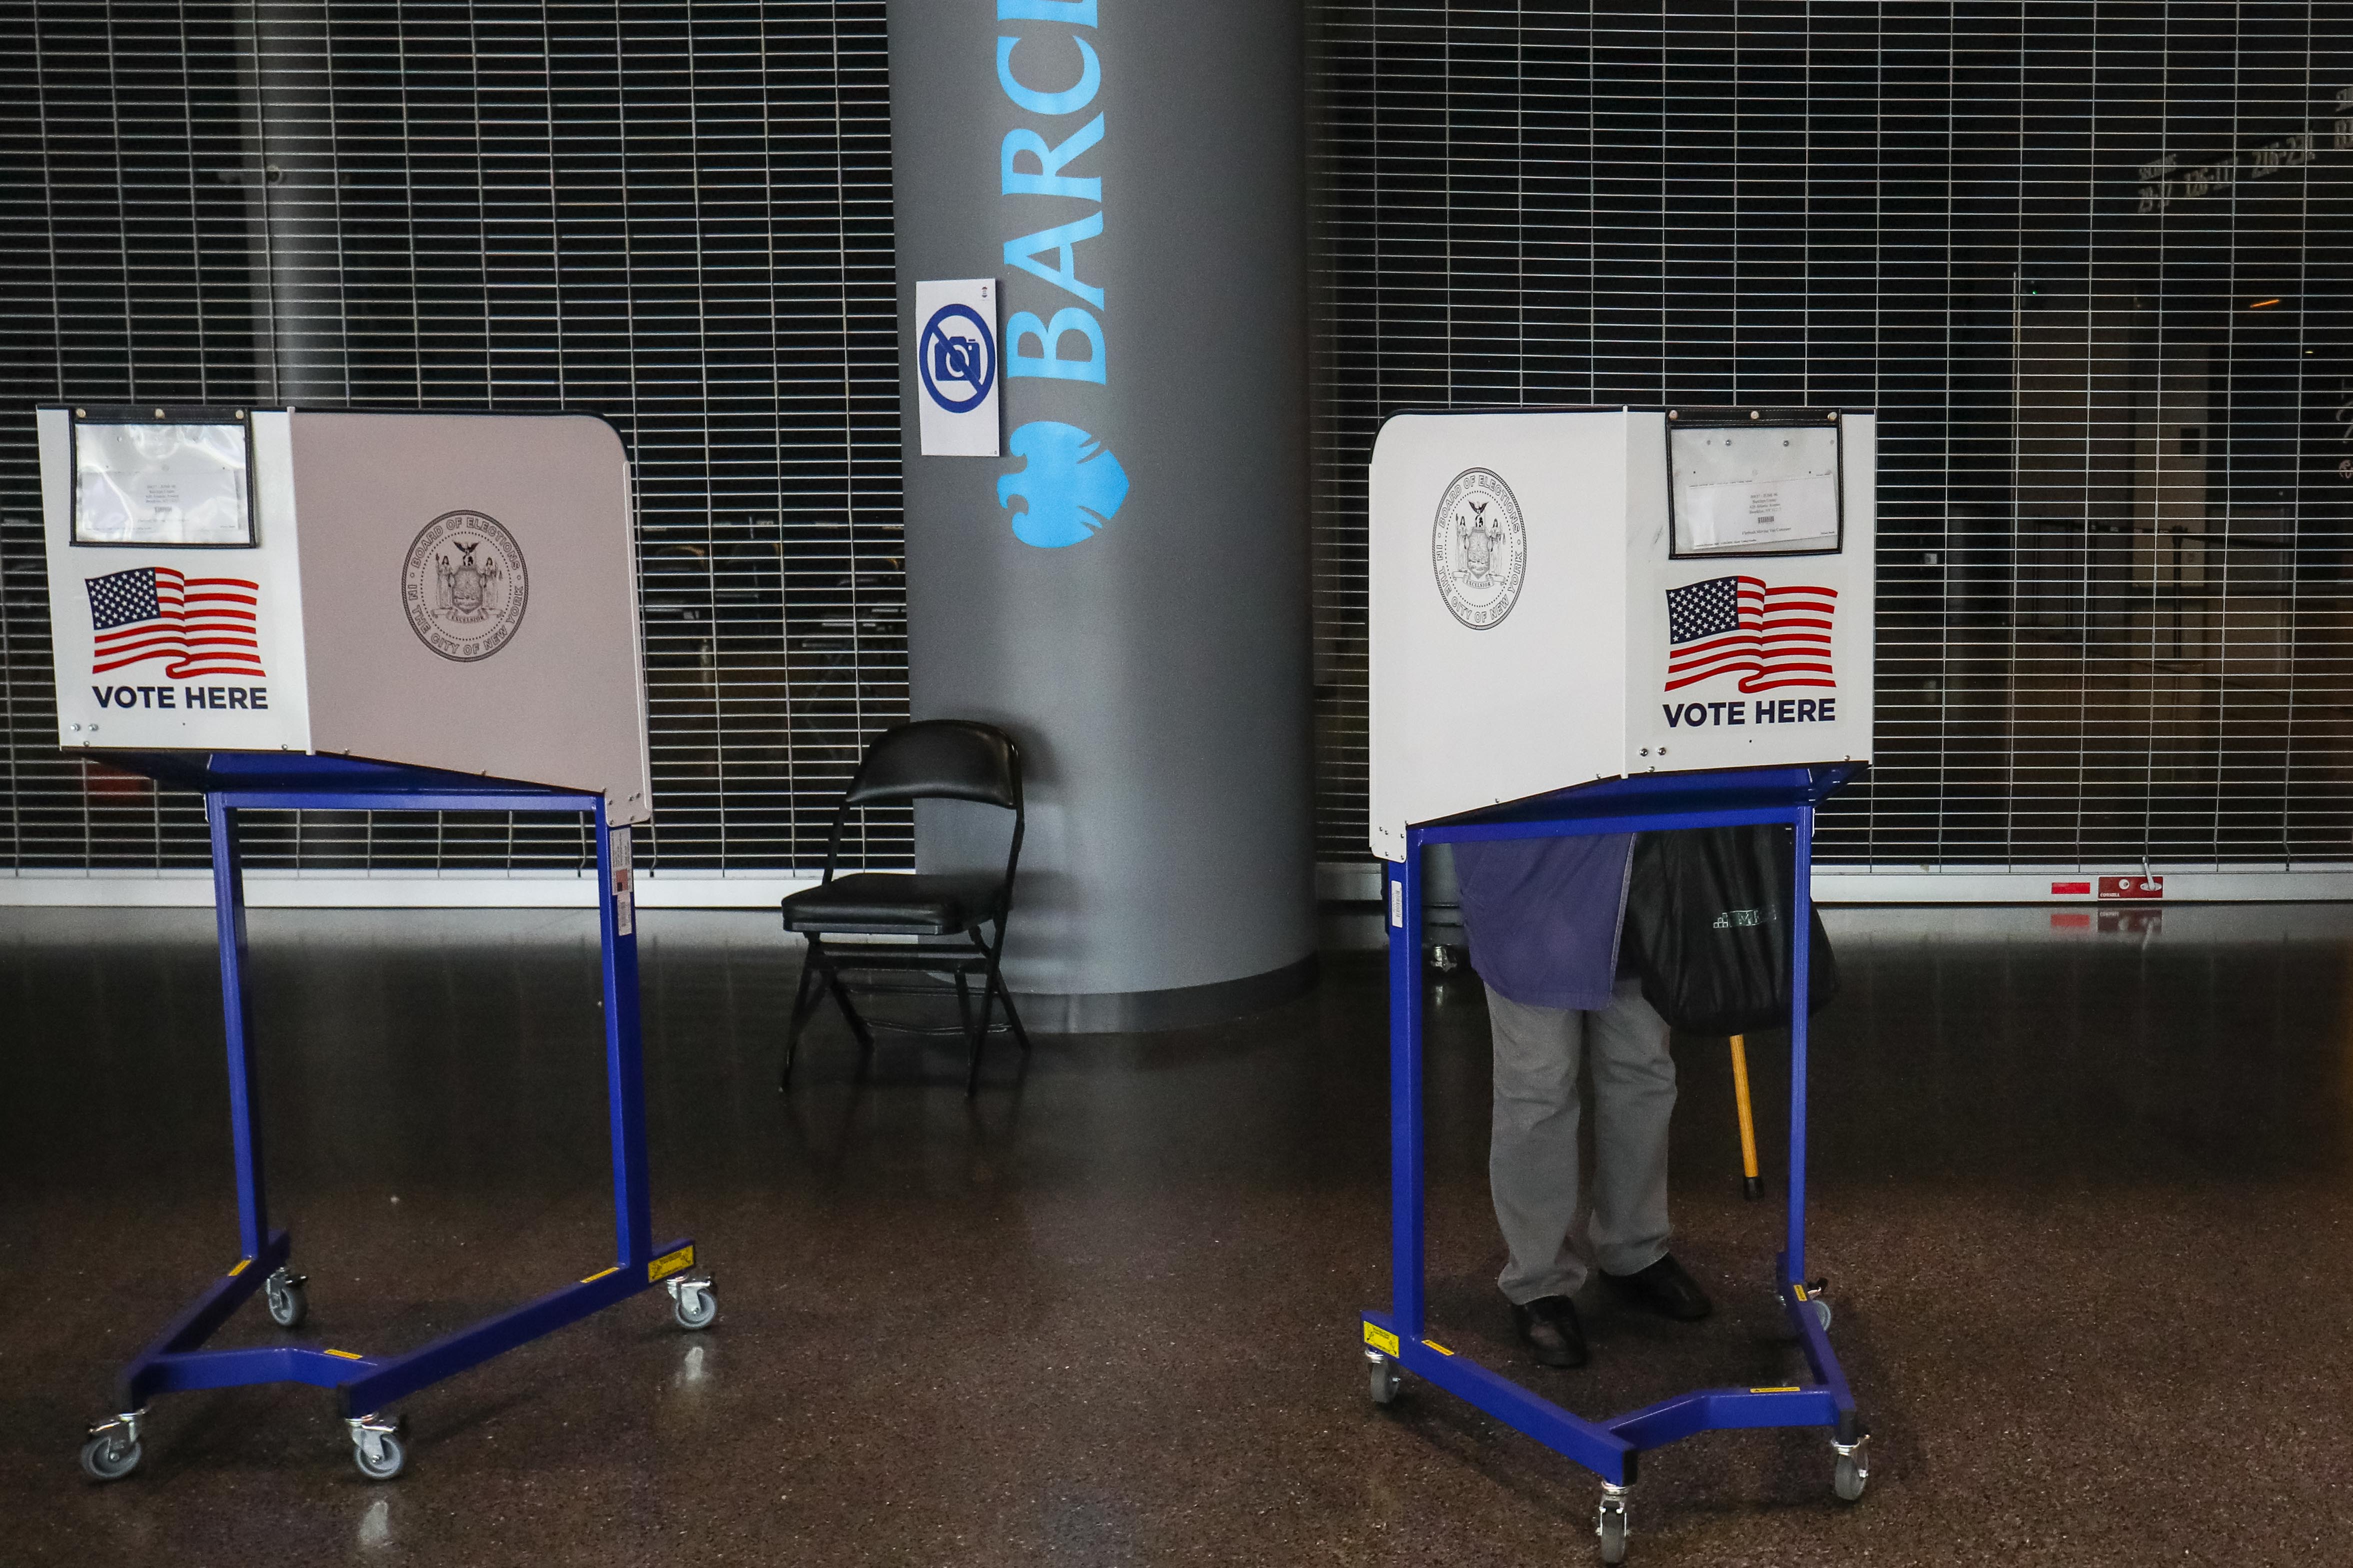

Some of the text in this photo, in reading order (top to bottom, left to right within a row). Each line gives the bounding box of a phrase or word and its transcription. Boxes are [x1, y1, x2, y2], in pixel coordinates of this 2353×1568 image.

[1438, 475, 1520, 533] BOARD OF ELECTIONS
[411, 517, 520, 570] BOARD OF ELECTIONS
[1436, 545, 1522, 623] IN THE CITY OF NEW YORK
[1466, 579, 1491, 588] EXCELSIOR
[408, 584, 524, 655] IN THE CITY OF NEW YORK
[92, 686, 268, 709] VOTE HERE
[1662, 698, 1836, 728] VOTE HERE
